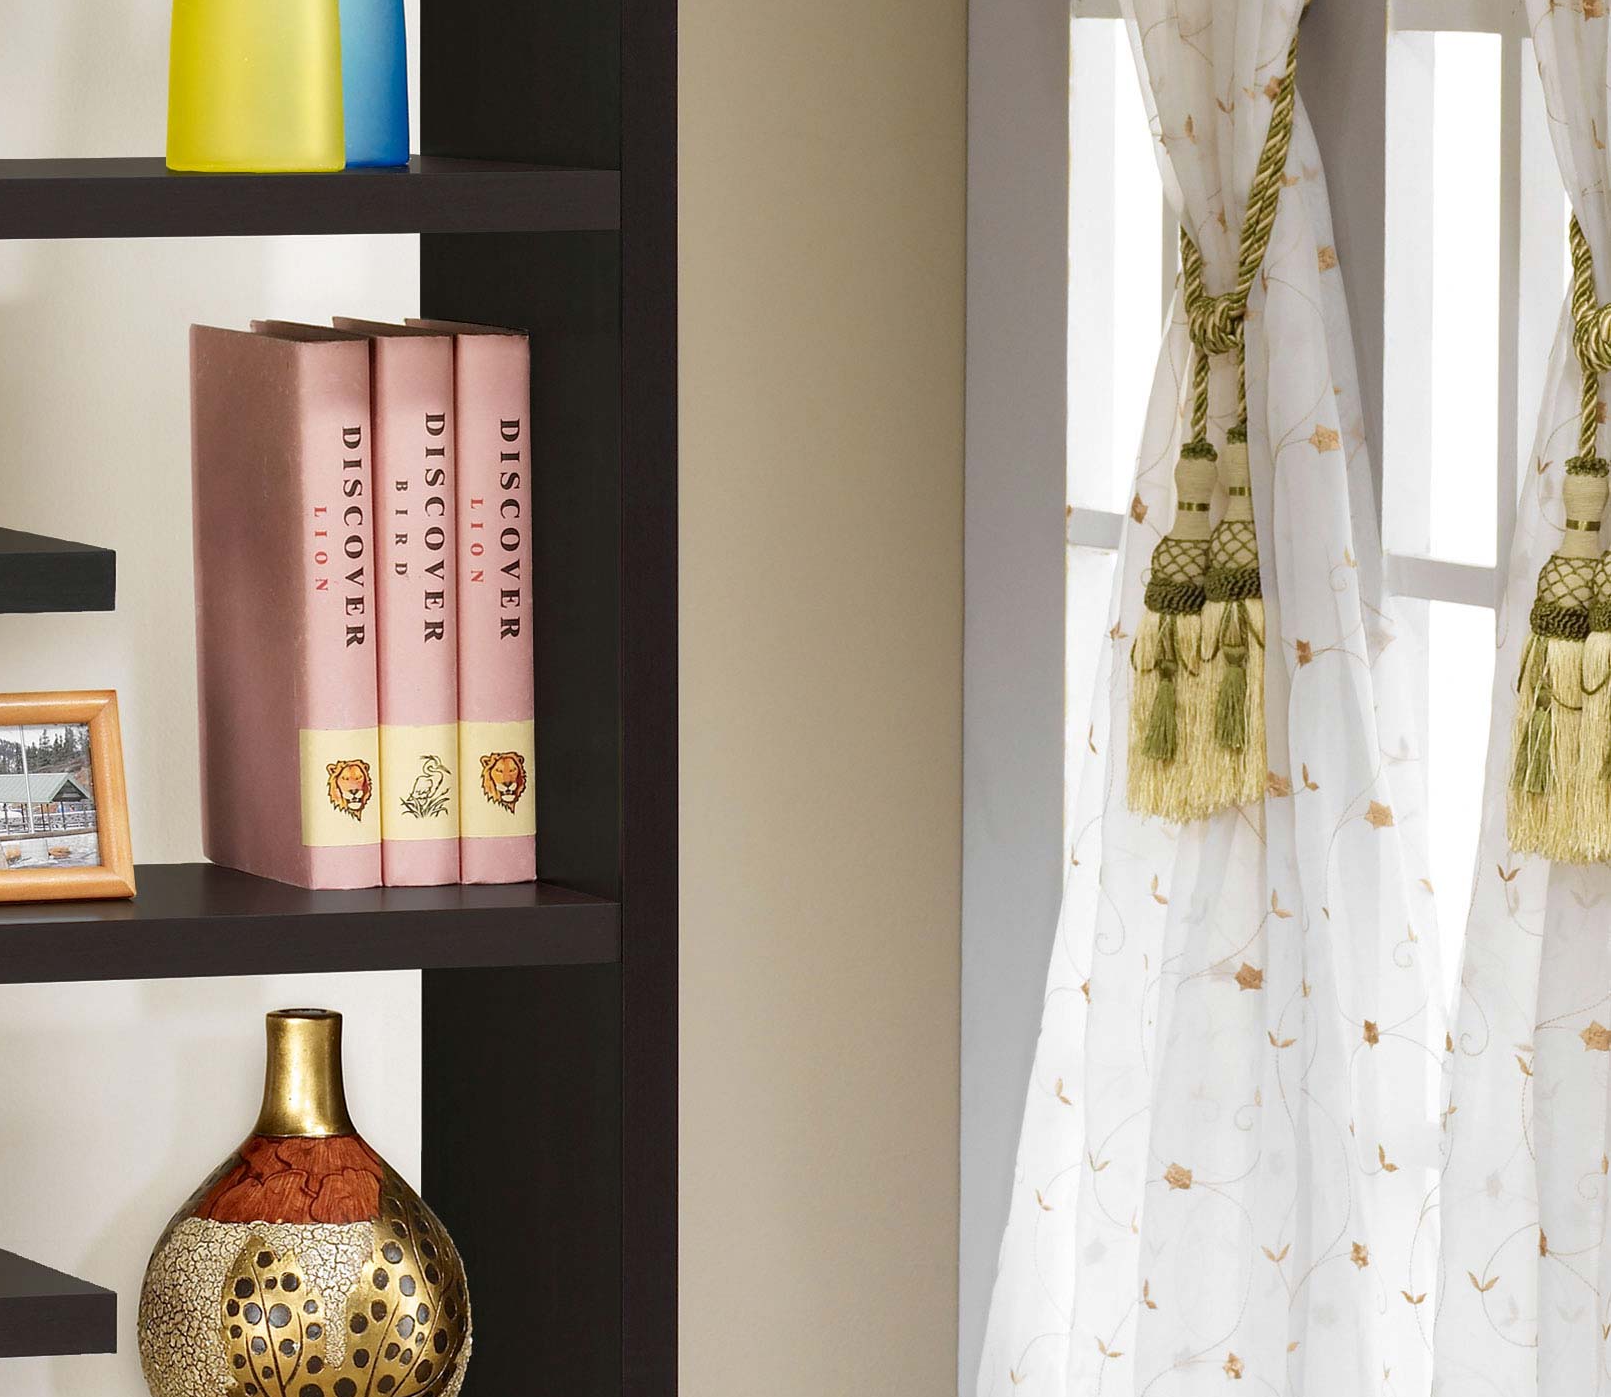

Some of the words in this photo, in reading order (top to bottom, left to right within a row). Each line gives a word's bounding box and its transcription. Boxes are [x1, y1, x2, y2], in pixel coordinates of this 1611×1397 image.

[314, 506, 329, 592] LION
[342, 425, 365, 648] DISCOVER
[395, 480, 408, 577] BIRD
[424, 412, 446, 643] DISCOVER
[470, 498, 484, 583] LION
[500, 418, 521, 641] DISCOVER
